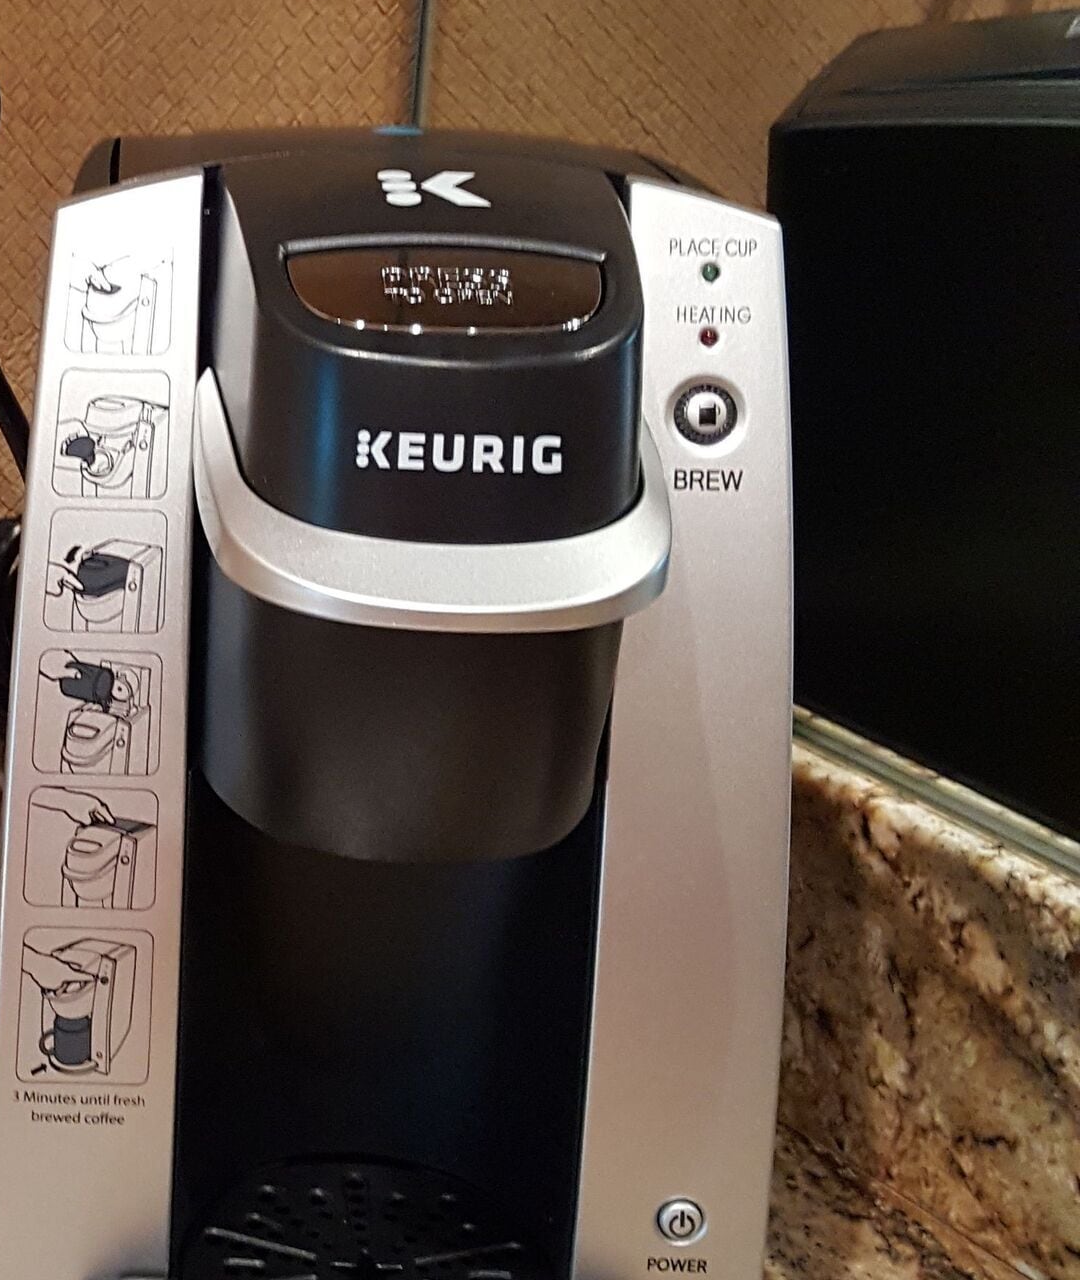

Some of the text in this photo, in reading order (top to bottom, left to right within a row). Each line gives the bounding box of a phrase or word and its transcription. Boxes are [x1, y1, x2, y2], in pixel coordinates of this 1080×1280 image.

[669, 237, 757, 257] PLACE CUP
[676, 305, 751, 324] HEATING
[356, 429, 563, 474] KEURIG
[673, 469, 744, 492] BREW
[23, 1091, 77, 1105] Minutes
[80, 1093, 110, 1105] until
[113, 1094, 145, 1107] fresh
[31, 1110, 125, 1125] brewed coffee
[647, 1257, 708, 1273] POWER
